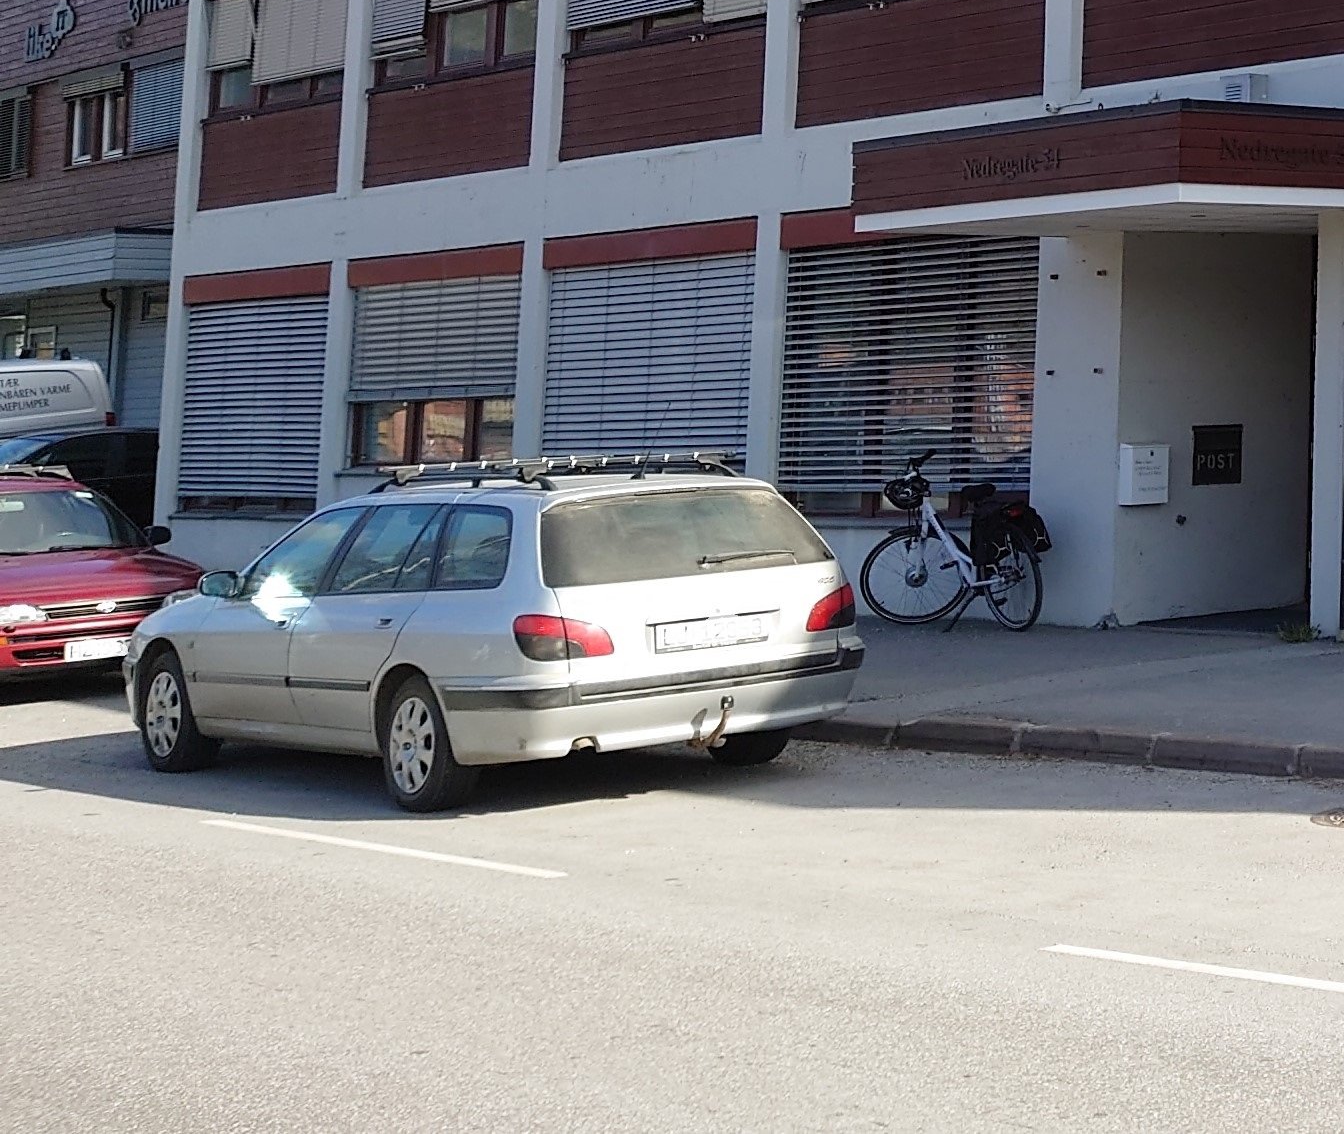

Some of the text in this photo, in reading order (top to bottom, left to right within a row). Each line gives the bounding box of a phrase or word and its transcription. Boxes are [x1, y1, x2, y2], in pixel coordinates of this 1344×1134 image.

[1220, 136, 1329, 169] Nedregate
[961, 153, 1038, 181] Nedregate
[40, 384, 71, 395] VARME
[1197, 452, 1235, 471] POST
